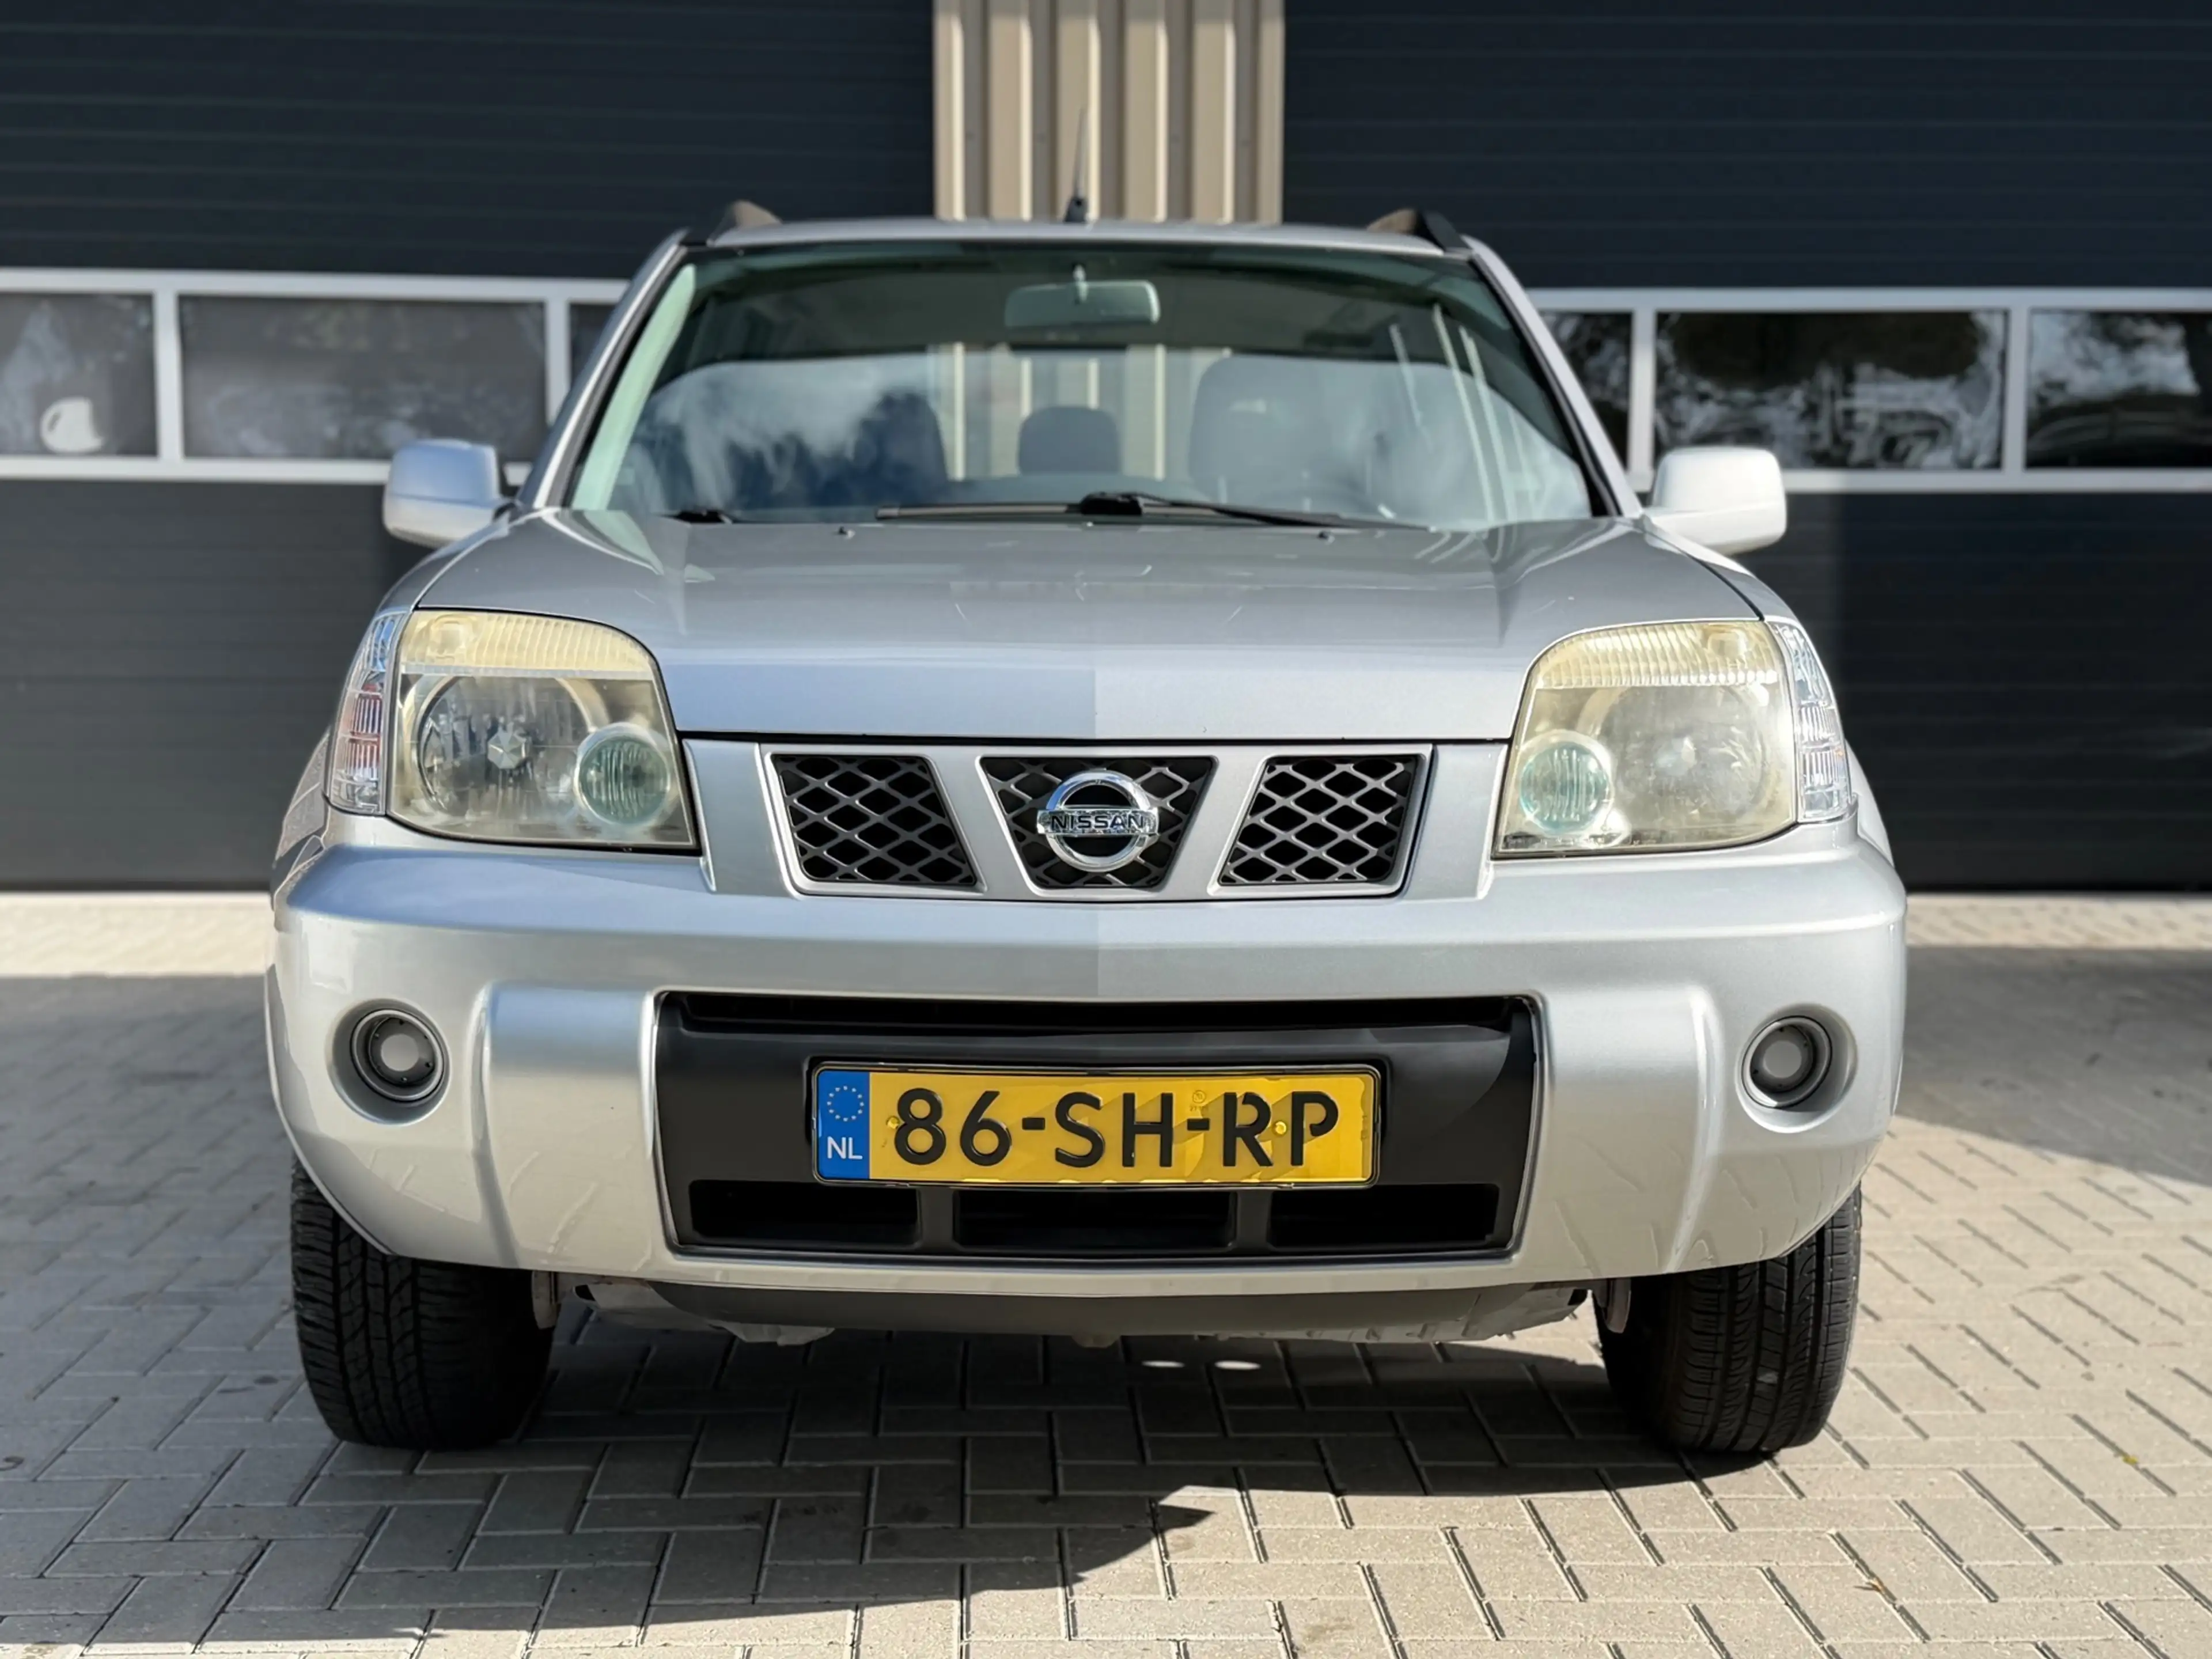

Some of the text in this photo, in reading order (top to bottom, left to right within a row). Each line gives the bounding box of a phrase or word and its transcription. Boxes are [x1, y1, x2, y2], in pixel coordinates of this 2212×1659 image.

[1051, 815, 1143, 828] NISSAN
[894, 1088, 1339, 1167] 86-SH-RP
[827, 1136, 863, 1160] NL
